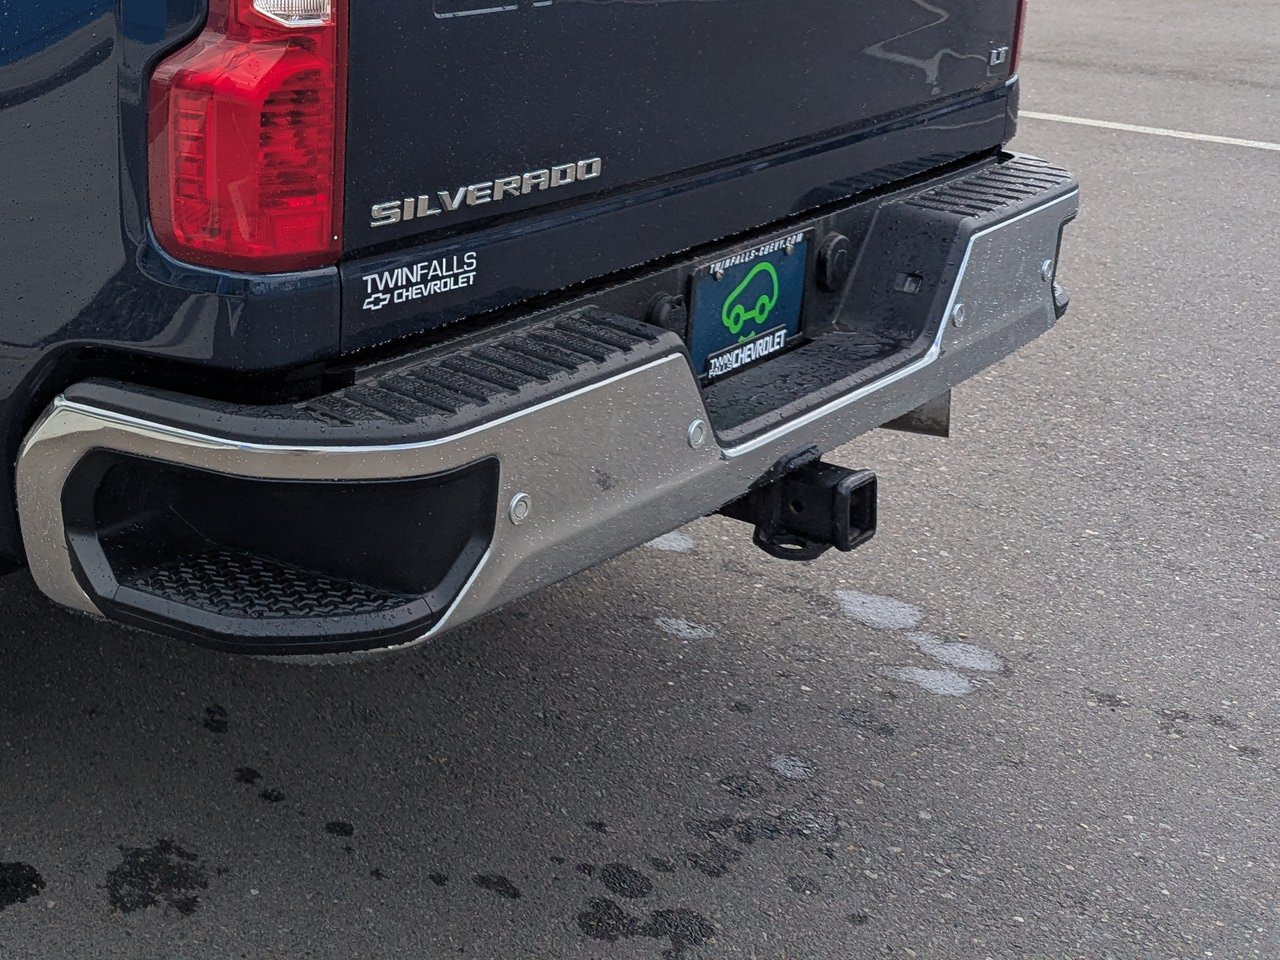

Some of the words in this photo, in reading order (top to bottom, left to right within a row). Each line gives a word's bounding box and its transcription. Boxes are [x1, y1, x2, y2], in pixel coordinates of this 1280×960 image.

[990, 46, 1009, 66] LT
[370, 157, 602, 228] SILVERADO
[362, 251, 477, 294] TWINFALLS
[393, 271, 477, 304] CHEVROLET
[710, 352, 733, 370] TWIN
[732, 329, 787, 368] CHEVROLET
[708, 361, 733, 379] FALLS
